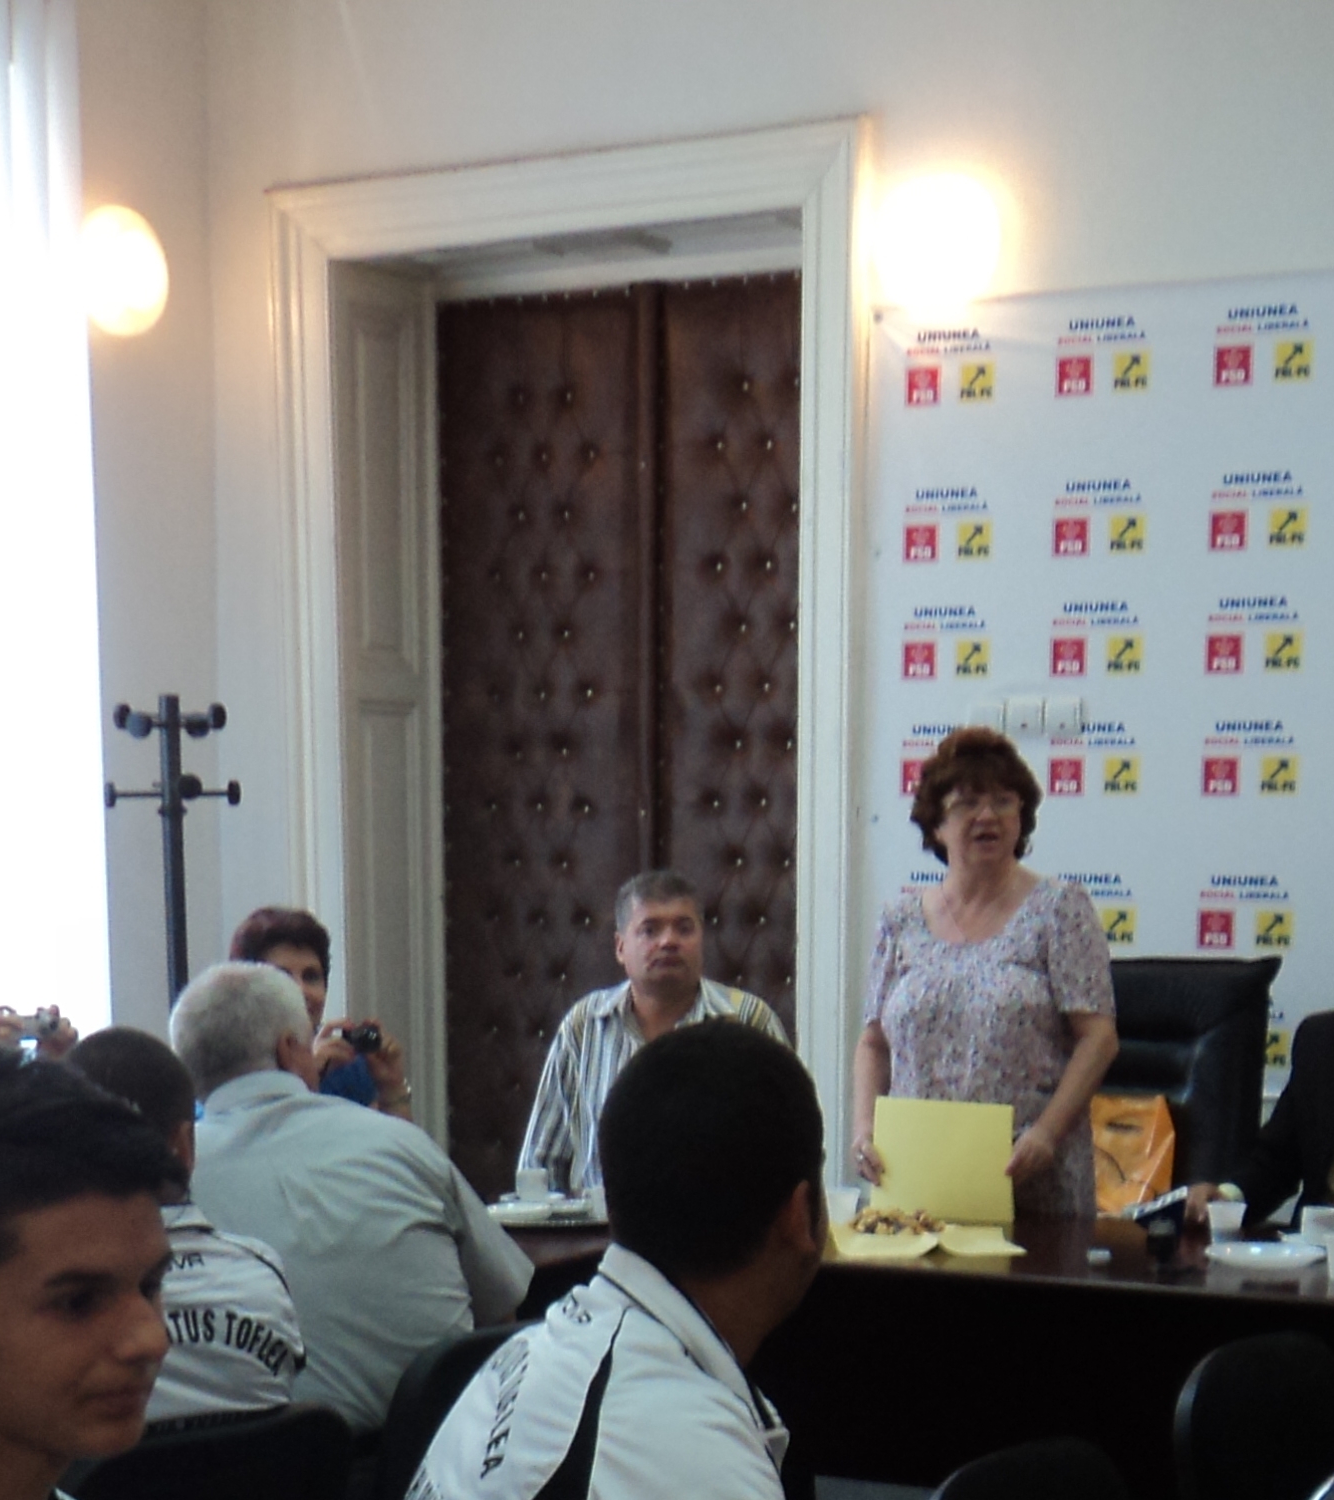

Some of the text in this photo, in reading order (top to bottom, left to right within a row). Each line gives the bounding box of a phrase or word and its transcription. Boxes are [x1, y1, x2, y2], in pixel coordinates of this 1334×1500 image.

[1228, 303, 1298, 319] UNIUNEA
[1069, 315, 1135, 330] UNIUNEA
[917, 326, 980, 341] UNIUNEA
[1222, 367, 1246, 381] PSD
[1063, 377, 1086, 391] PSD
[912, 387, 934, 400] PSD
[1223, 470, 1292, 485] UNIUNEA
[1065, 477, 1131, 492] UNIUNEA
[915, 485, 978, 499] UNIUNEA
[1060, 539, 1082, 552] PSD
[1217, 533, 1240, 546] PSD
[910, 545, 932, 557] PSD
[1063, 599, 1128, 613] UNIUNEA
[1219, 594, 1288, 608] UNIUNEA
[914, 604, 976, 617] UNIUNEA
[909, 662, 930, 674] PSD
[1057, 659, 1080, 671] PSD
[1213, 656, 1236, 668] PSD
[1215, 719, 1284, 731] UNIUNEA
[1055, 779, 1077, 791] PSD
[1209, 779, 1233, 790] PSD
[1211, 874, 1278, 886] UNIUNEA
[1205, 931, 1228, 943] PSD
